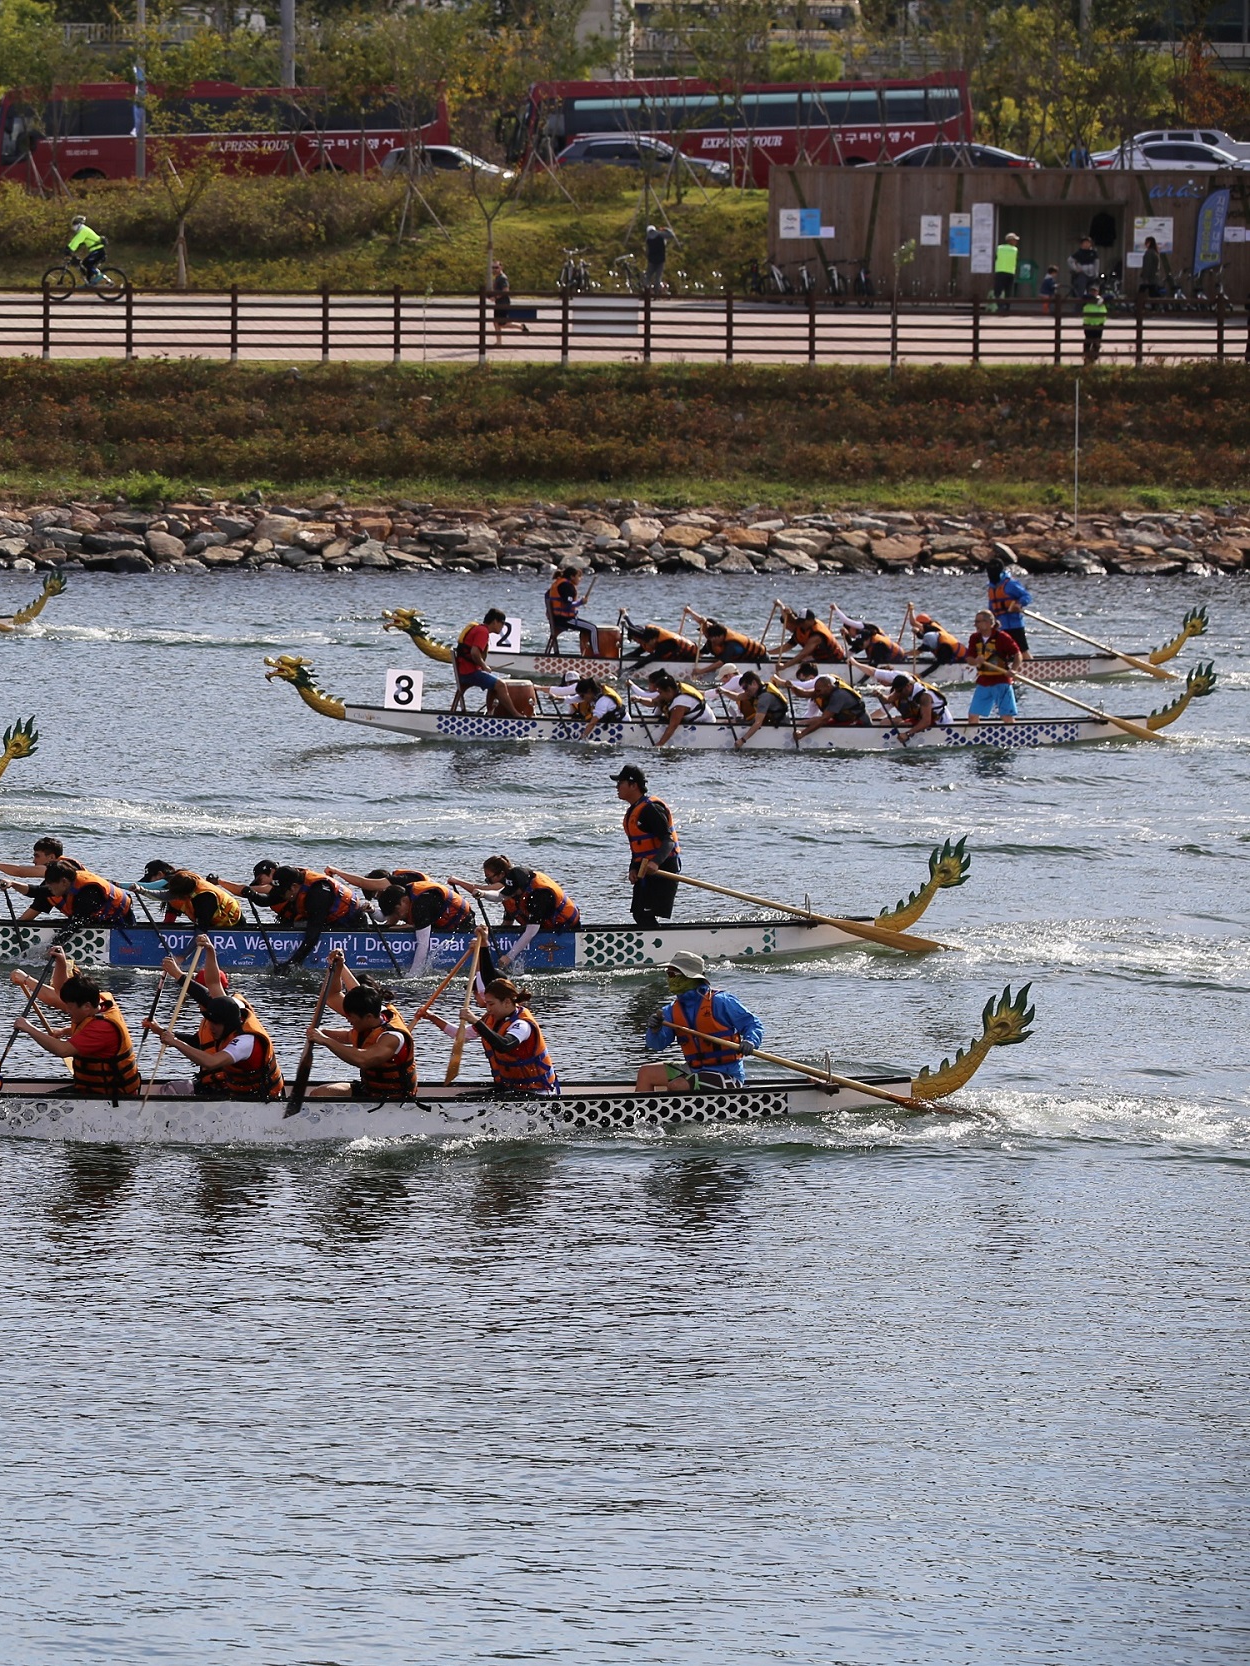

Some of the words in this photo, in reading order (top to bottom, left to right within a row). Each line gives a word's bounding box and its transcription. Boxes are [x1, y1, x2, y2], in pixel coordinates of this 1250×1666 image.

[496, 622, 512, 648] 2
[394, 675, 414, 705] 3
[158, 935, 194, 950] 2017
[243, 936, 321, 953] Waterwy
